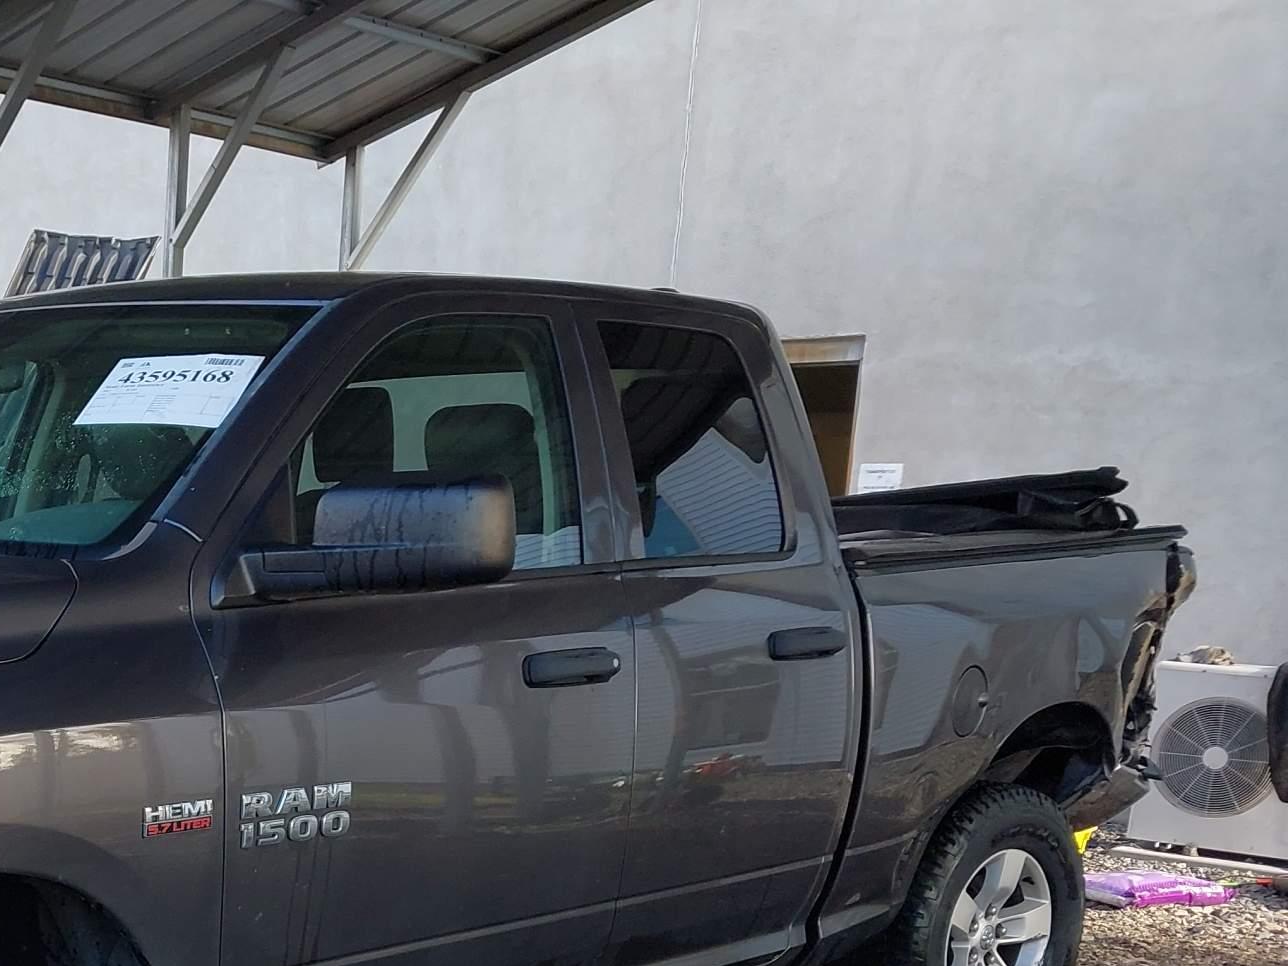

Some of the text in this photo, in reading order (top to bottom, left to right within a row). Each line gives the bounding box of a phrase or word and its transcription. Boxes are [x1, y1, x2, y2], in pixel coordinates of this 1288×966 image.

[117, 369, 234, 384] 43595168
[144, 799, 213, 823] HEMI
[241, 781, 352, 820] RAM
[148, 818, 210, 835] 5.7 LITER
[240, 810, 351, 849] 1500
